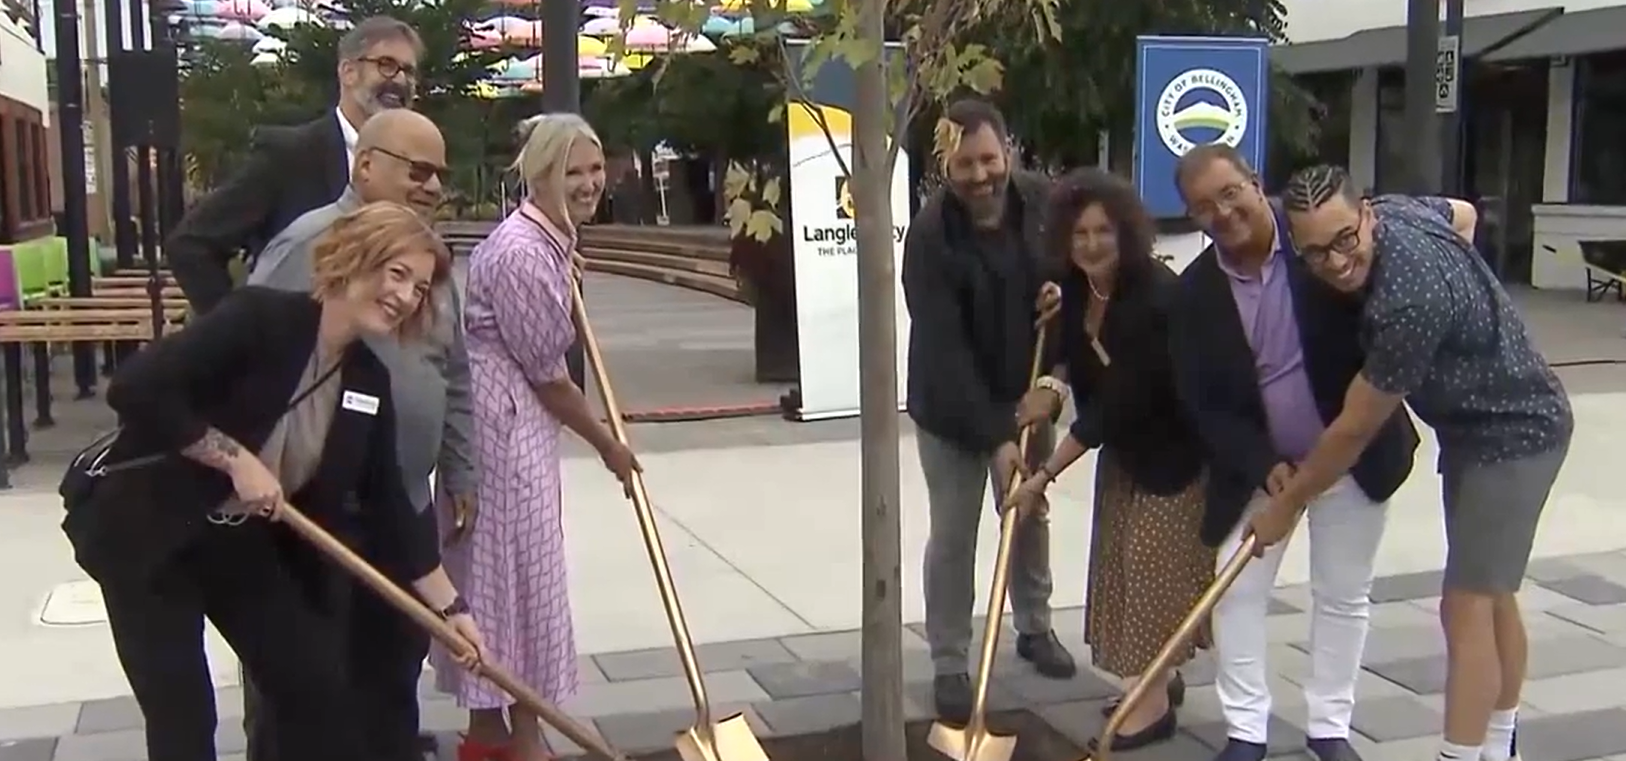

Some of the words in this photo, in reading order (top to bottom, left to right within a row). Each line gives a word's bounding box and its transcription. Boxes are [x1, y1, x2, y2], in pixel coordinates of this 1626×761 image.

[1161, 93, 1175, 117] CITY
[1174, 79, 1187, 92] OF
[1191, 75, 1242, 117] BELLINGHAM
[803, 223, 858, 245] Langle
[817, 247, 836, 257] THE
